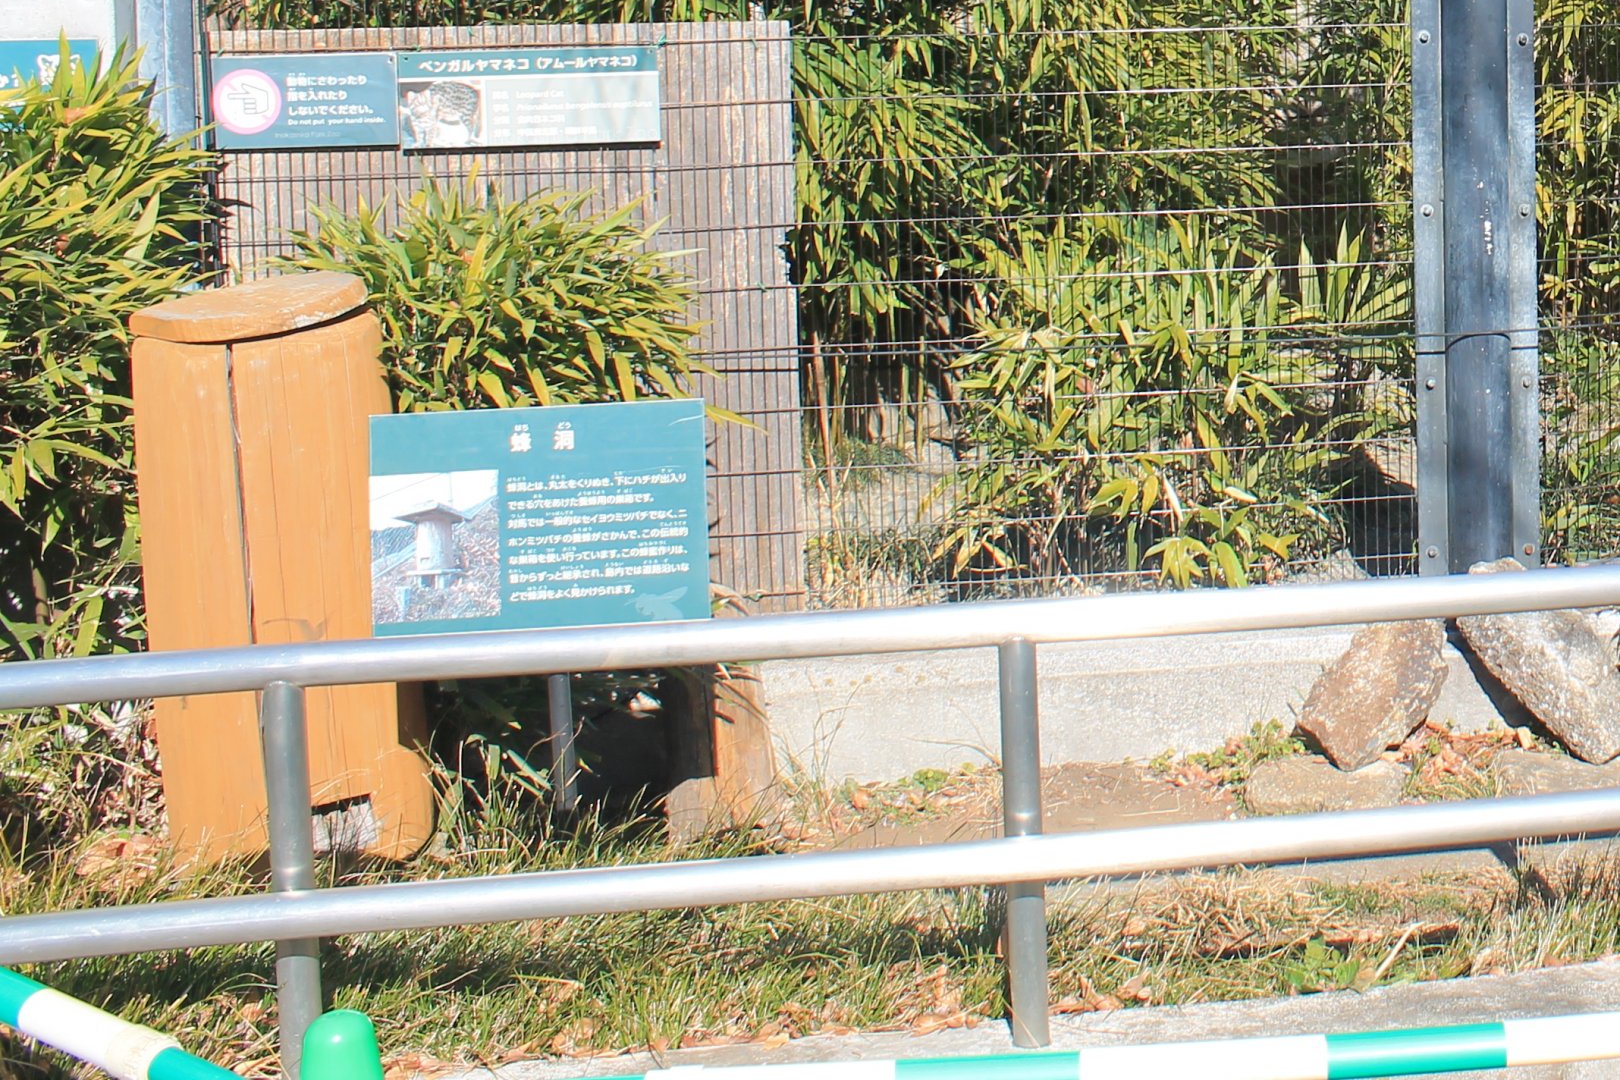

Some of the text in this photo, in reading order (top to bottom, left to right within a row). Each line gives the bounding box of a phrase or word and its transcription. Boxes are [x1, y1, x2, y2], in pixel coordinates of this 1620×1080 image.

[288, 105, 374, 116] しないでください。
[313, 118, 325, 126] put
[328, 118, 344, 126] your
[510, 430, 575, 453] 蜂 洞
